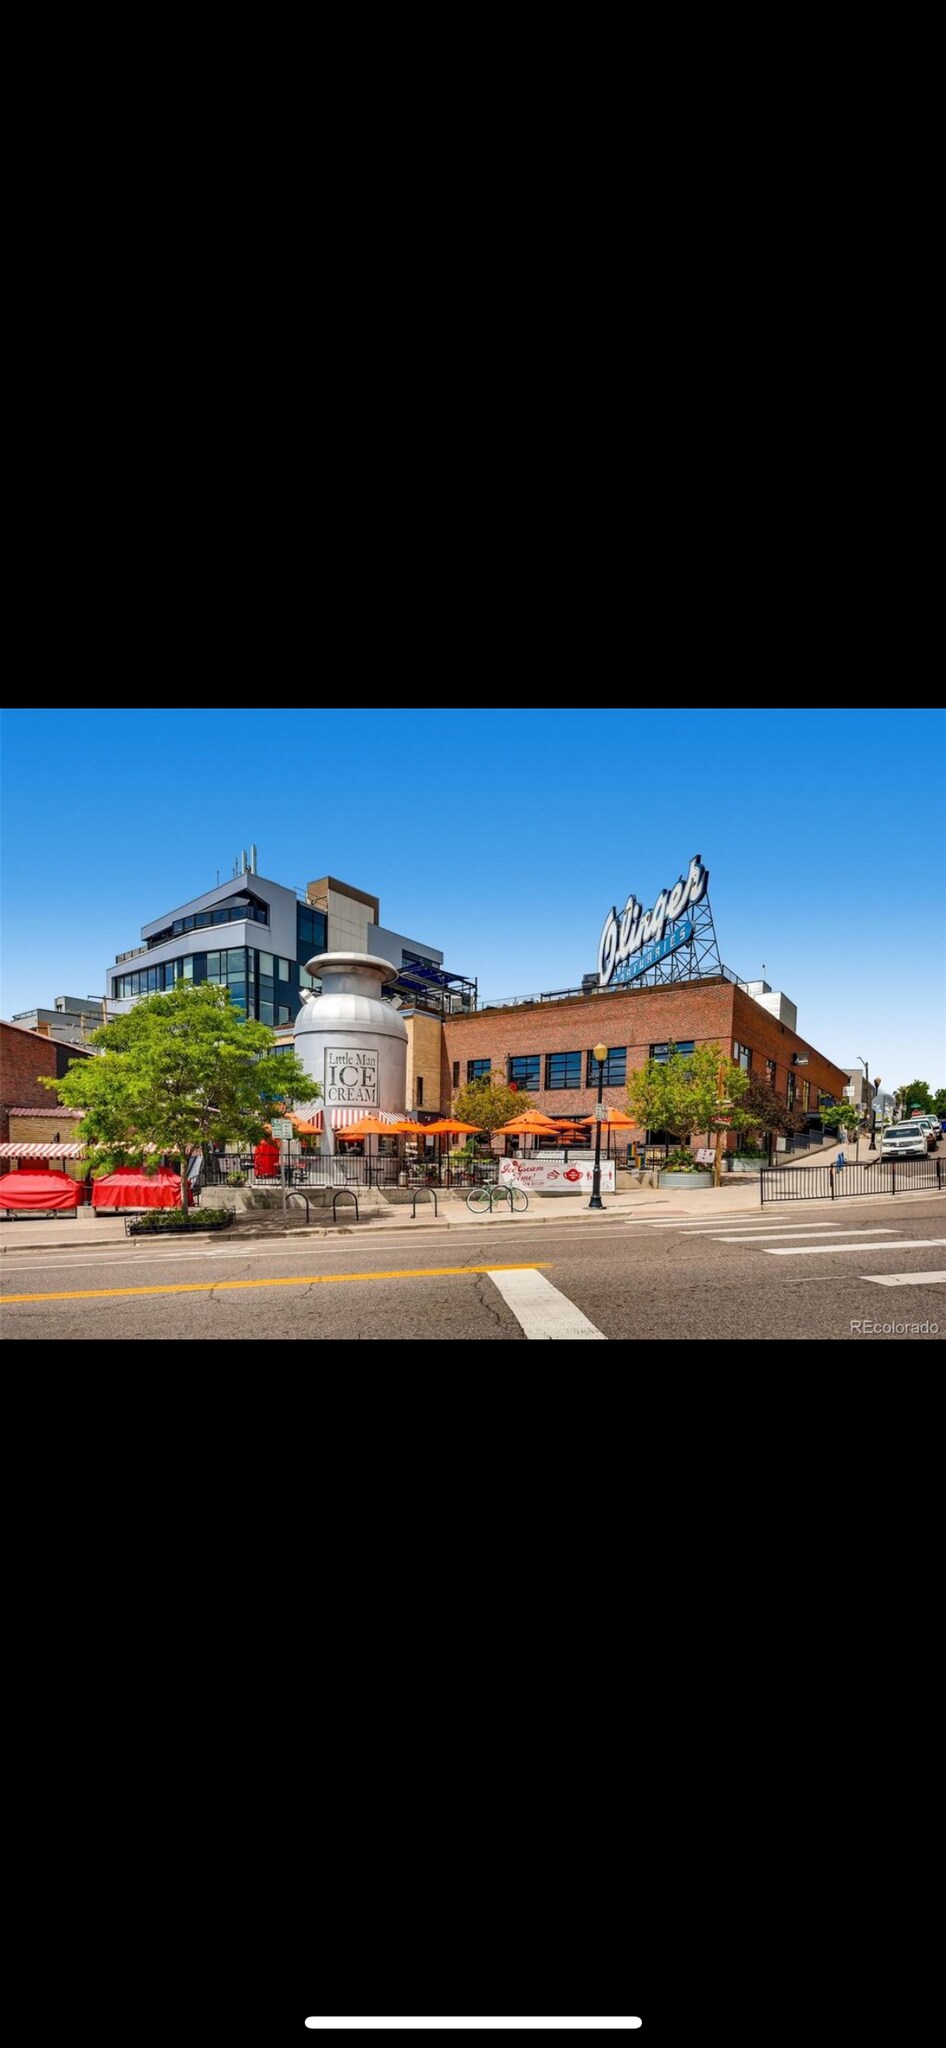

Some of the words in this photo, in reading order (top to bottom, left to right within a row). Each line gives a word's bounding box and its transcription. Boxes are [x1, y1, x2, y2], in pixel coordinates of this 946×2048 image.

[329, 1052, 353, 1065] Little
[356, 1053, 376, 1067] Man
[328, 1065, 376, 1088] ICE
[328, 1087, 376, 1103] CREAM
